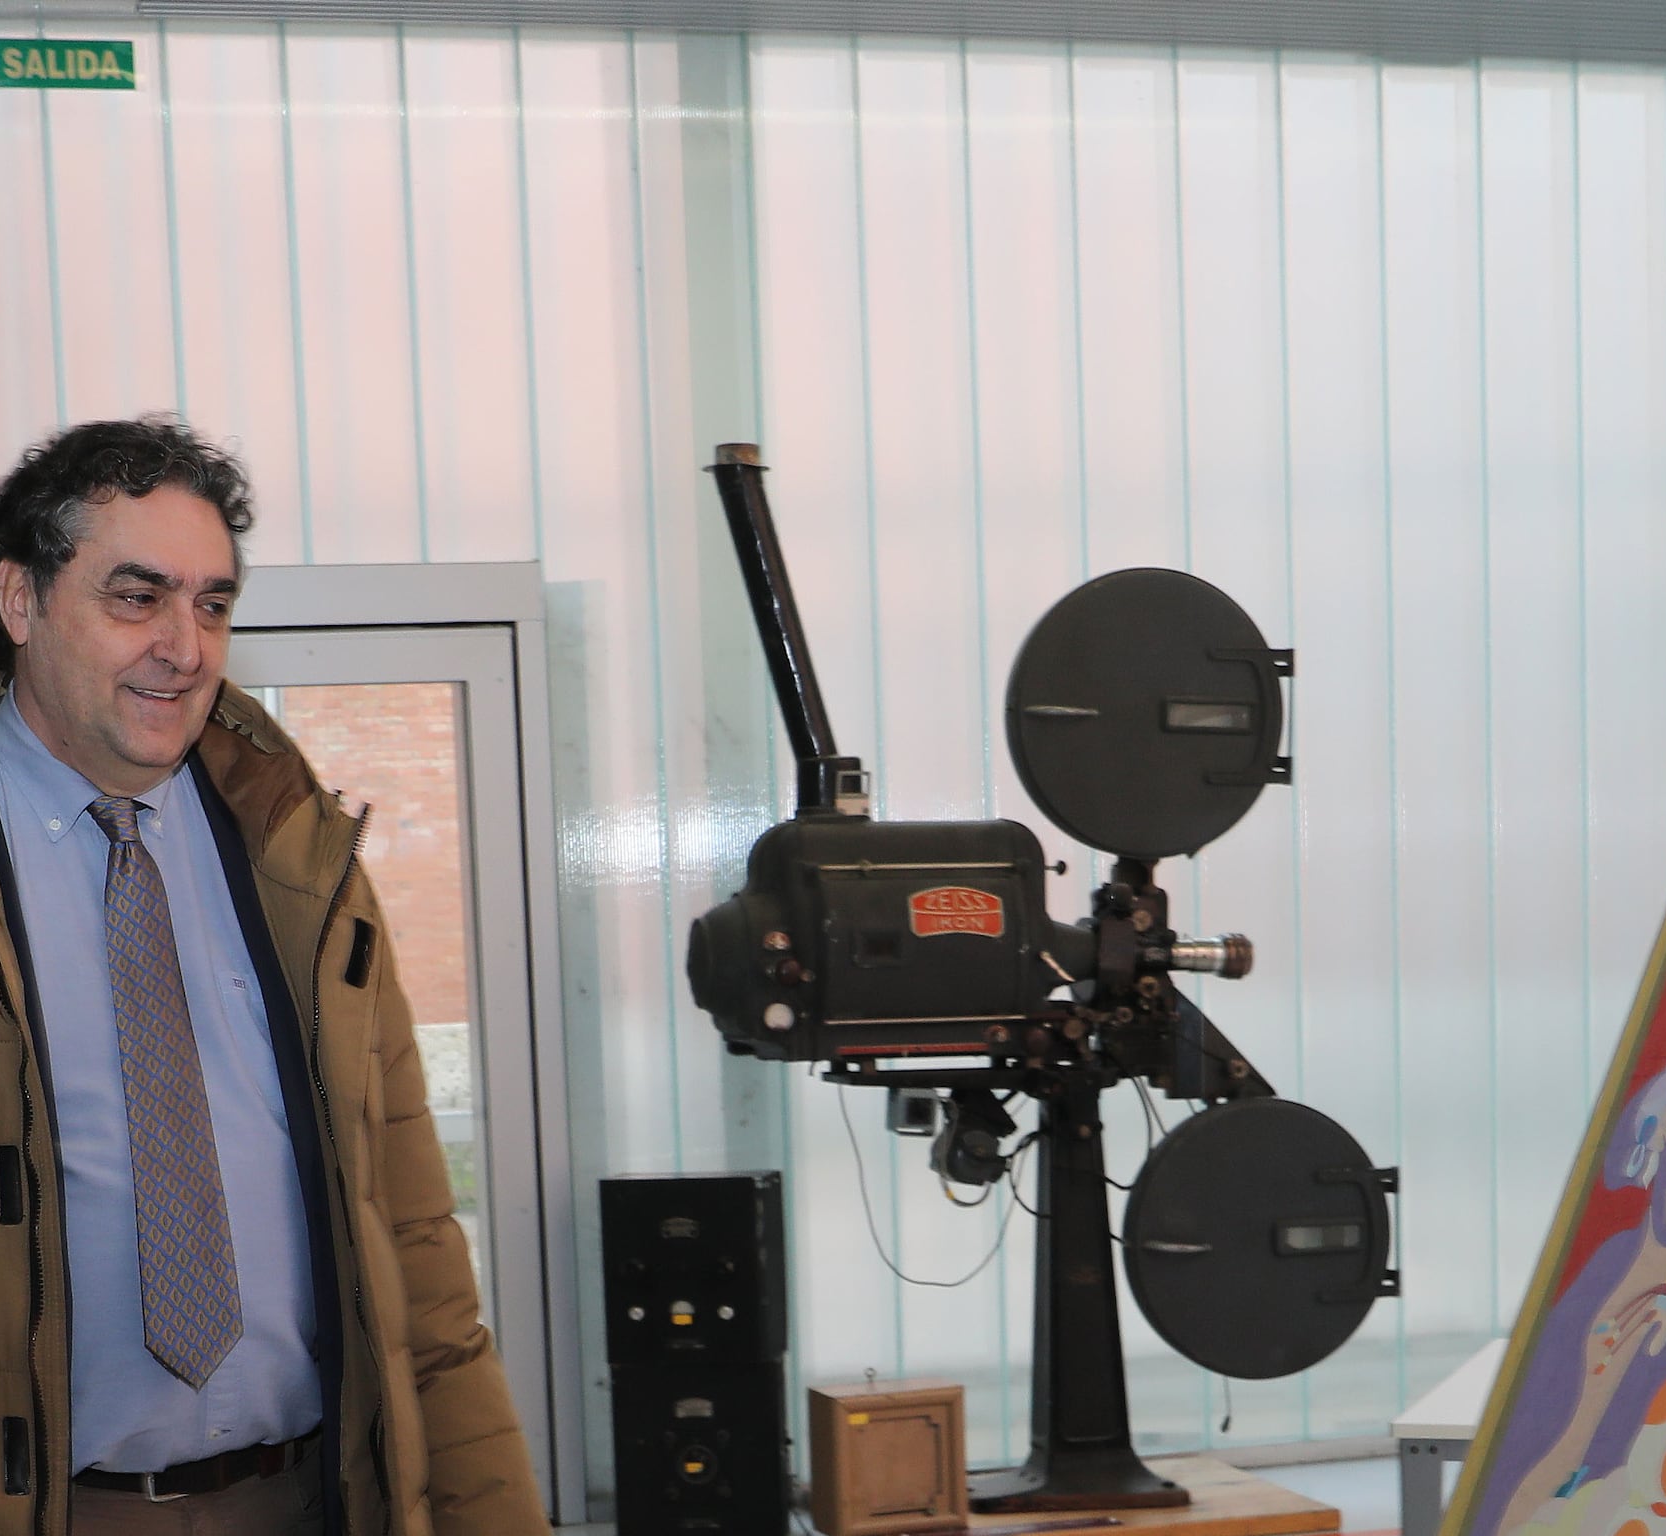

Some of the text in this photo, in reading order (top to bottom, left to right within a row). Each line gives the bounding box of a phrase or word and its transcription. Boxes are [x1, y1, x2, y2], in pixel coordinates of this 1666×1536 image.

[2, 47, 122, 80] SALIDA
[924, 891, 989, 911] ZEISS
[935, 916, 986, 930] IKON
